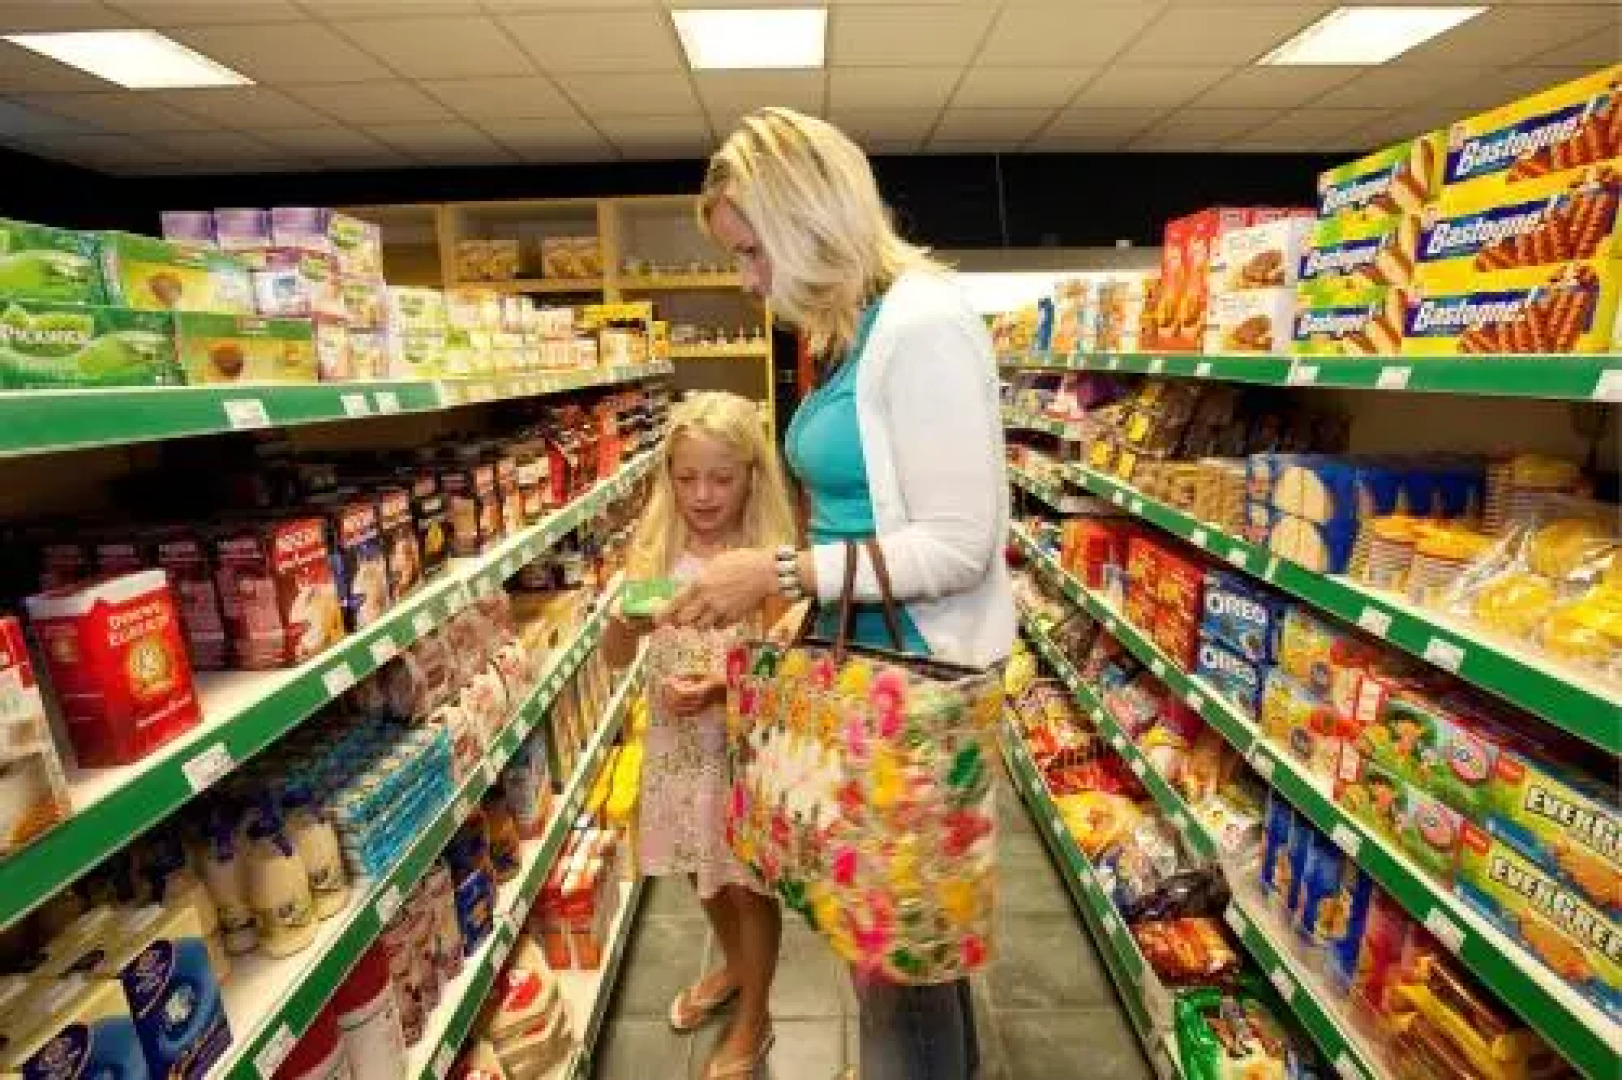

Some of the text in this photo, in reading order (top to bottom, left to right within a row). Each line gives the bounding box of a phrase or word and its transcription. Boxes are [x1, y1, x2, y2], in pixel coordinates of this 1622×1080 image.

[1456, 96, 1598, 176] Bastogne!
[1427, 193, 1560, 254] Bastogne!
[1413, 285, 1539, 332] Bastogne!
[1206, 593, 1268, 625] OREO
